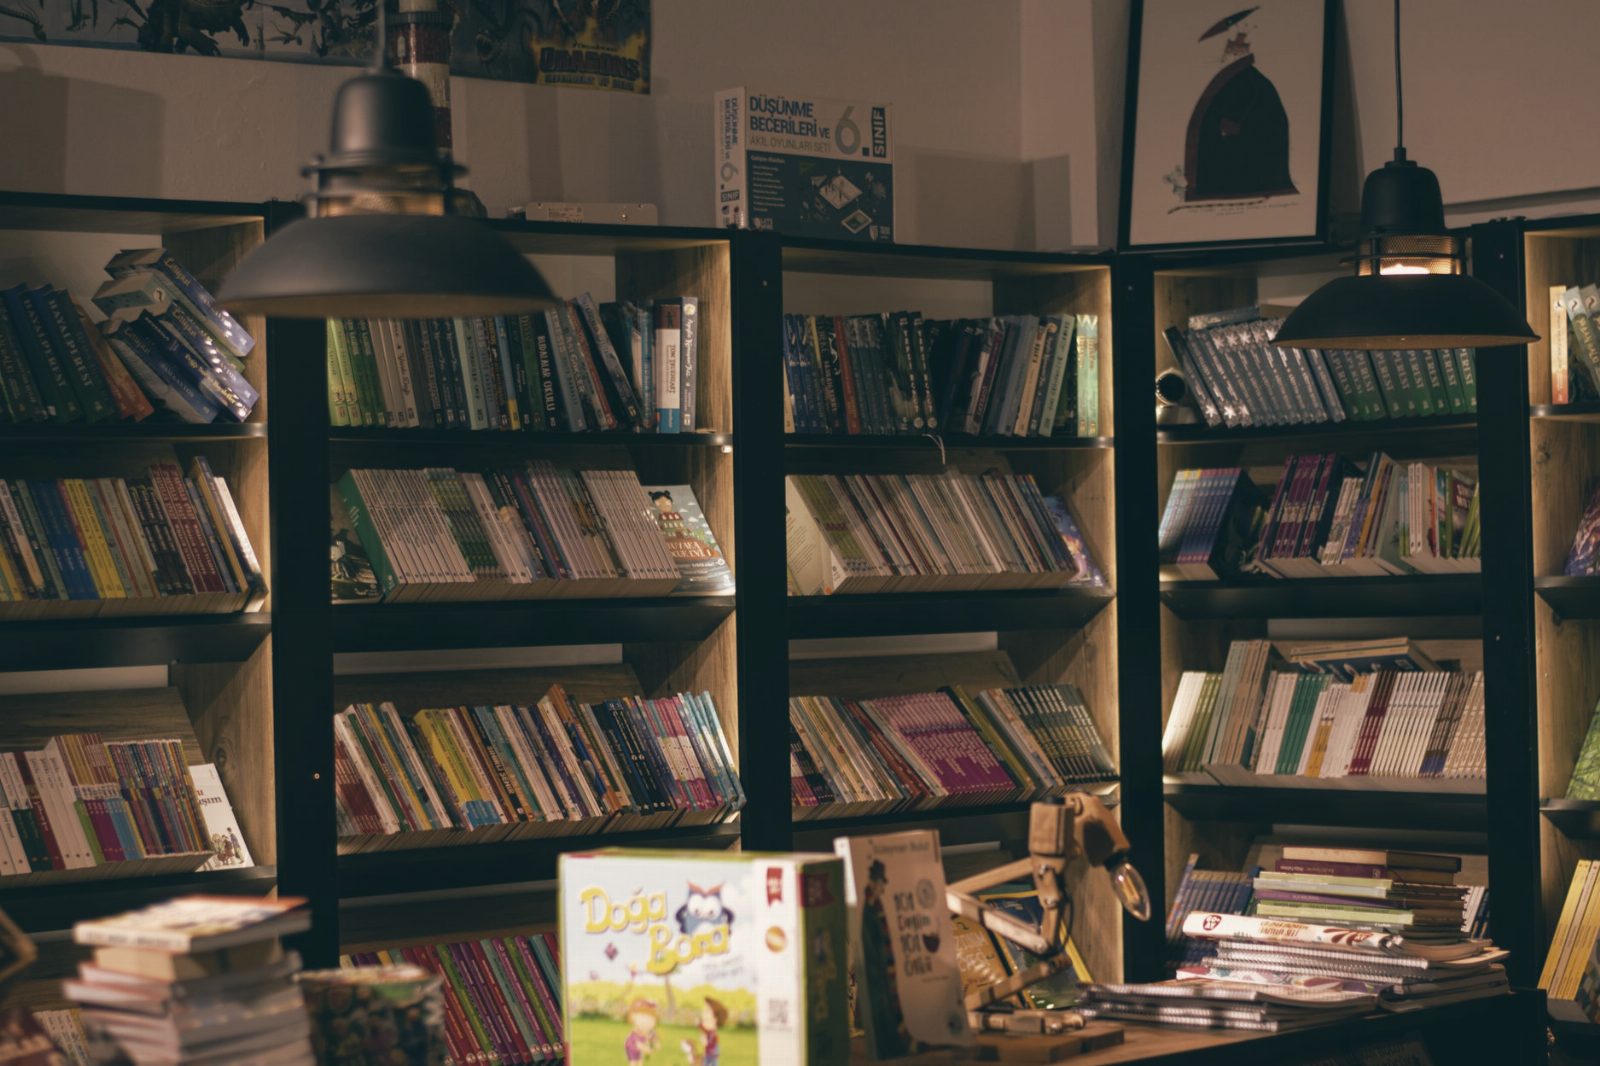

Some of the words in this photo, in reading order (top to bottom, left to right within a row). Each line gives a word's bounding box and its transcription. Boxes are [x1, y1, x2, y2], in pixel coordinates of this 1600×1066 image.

[749, 95, 814, 118] DÜŞÜNME
[750, 115, 817, 138] BECERİLERİ
[819, 127, 830, 139] VE
[770, 136, 812, 151] OYUNLARI
[873, 107, 886, 157] SINIF
[23, 298, 67, 387] HAYALPEREST
[47, 298, 94, 387] HAYALPEREST
[579, 885, 668, 935] Doğa
